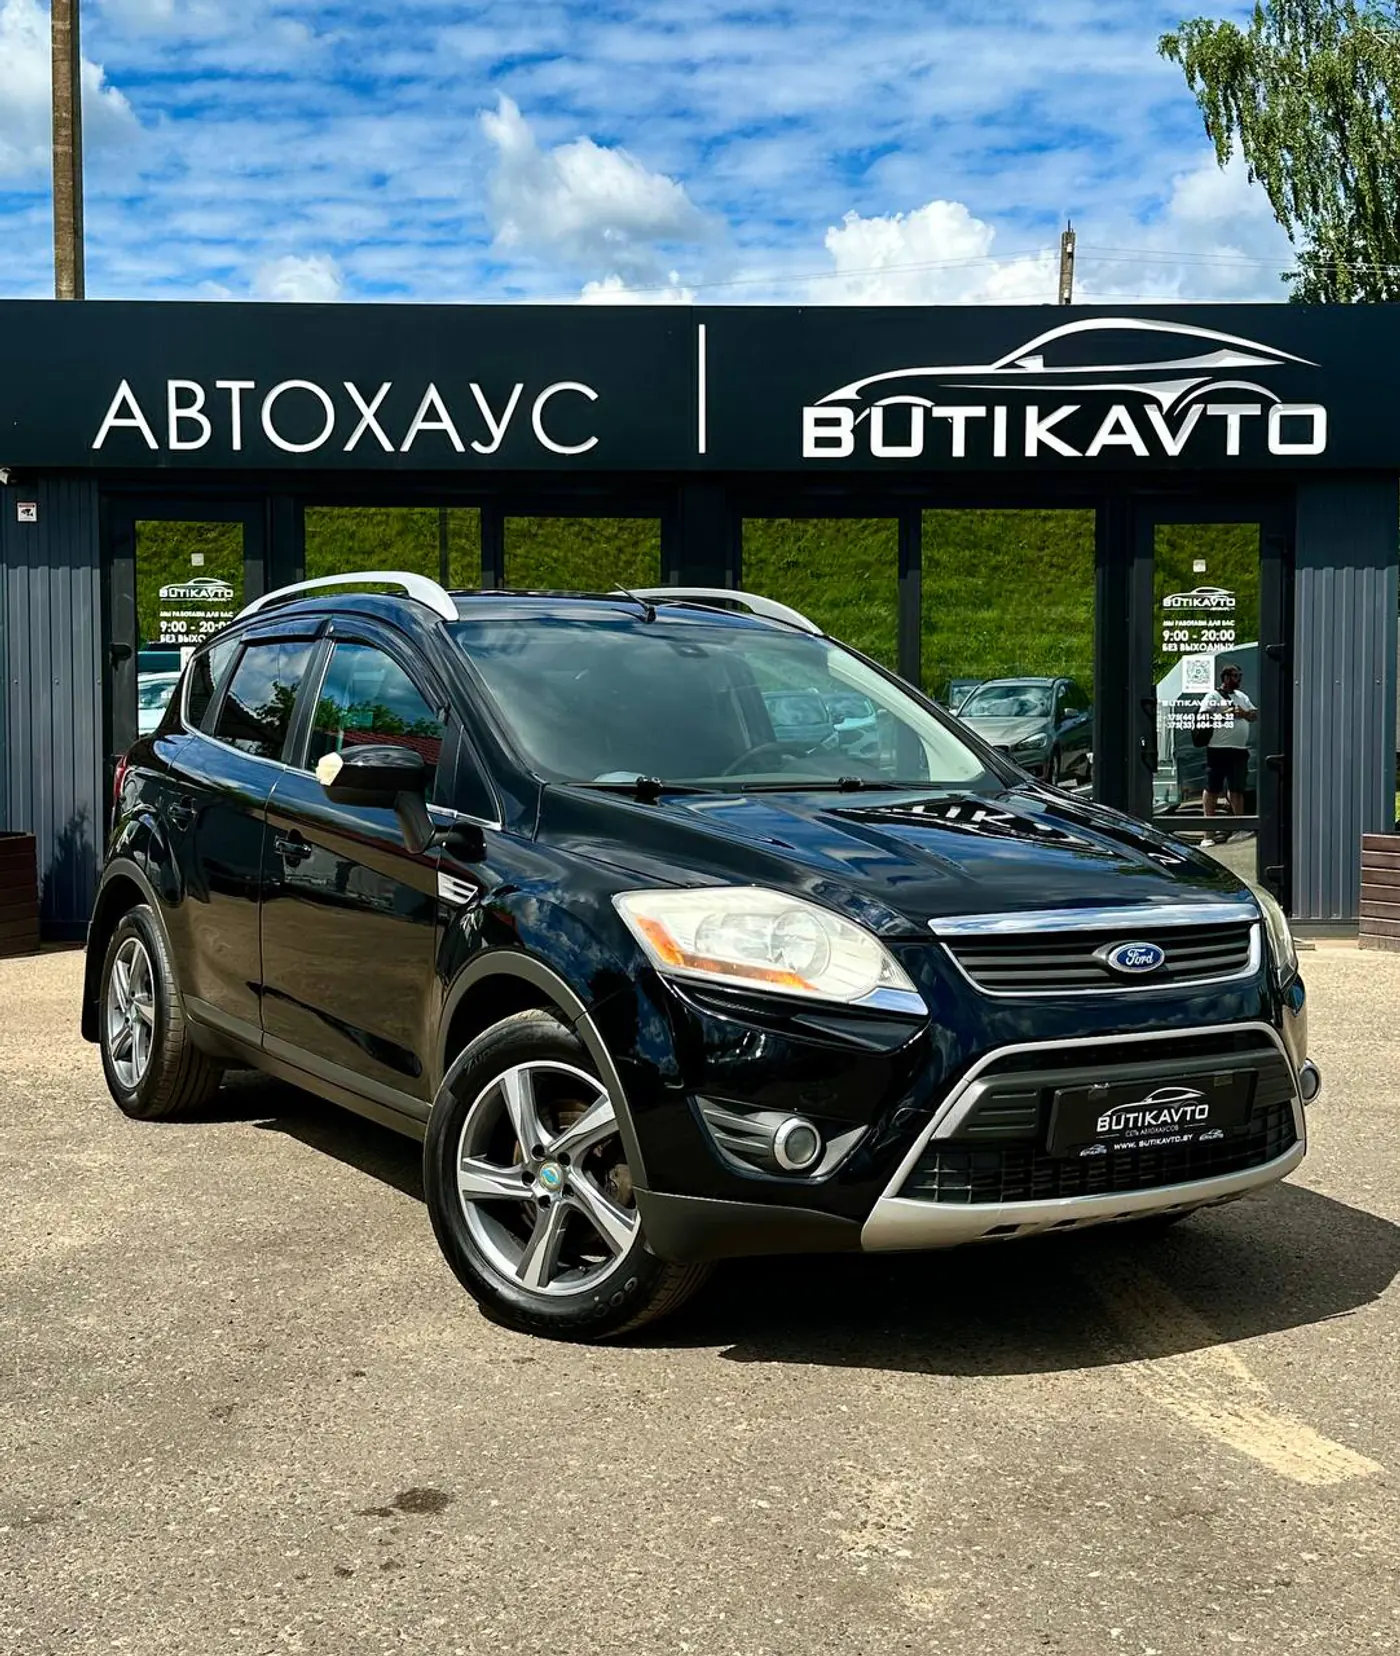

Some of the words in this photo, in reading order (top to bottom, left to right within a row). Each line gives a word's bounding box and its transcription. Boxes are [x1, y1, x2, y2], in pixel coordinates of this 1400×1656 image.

[91, 378, 601, 455] АВТОХАУС
[802, 402, 1327, 458] BUTIKAVTO
[159, 587, 234, 598] BUTIKAVTO
[1162, 597, 1236, 607] BUTIKAVTO
[160, 621, 187, 633] 9:00
[199, 621, 231, 632] 20:0
[160, 634, 176, 643] БЕЗ
[178, 634, 206, 642] ВЫХО
[1163, 630, 1189, 641] 9:00
[1201, 630, 1236, 641] 20:00
[1162, 643, 1178, 652] БЕЗ
[1180, 643, 1235, 652] ВЫХОДНЫХ
[1125, 948, 1154, 966] Ford
[1097, 1104, 1209, 1132] BUTIKAVTO
